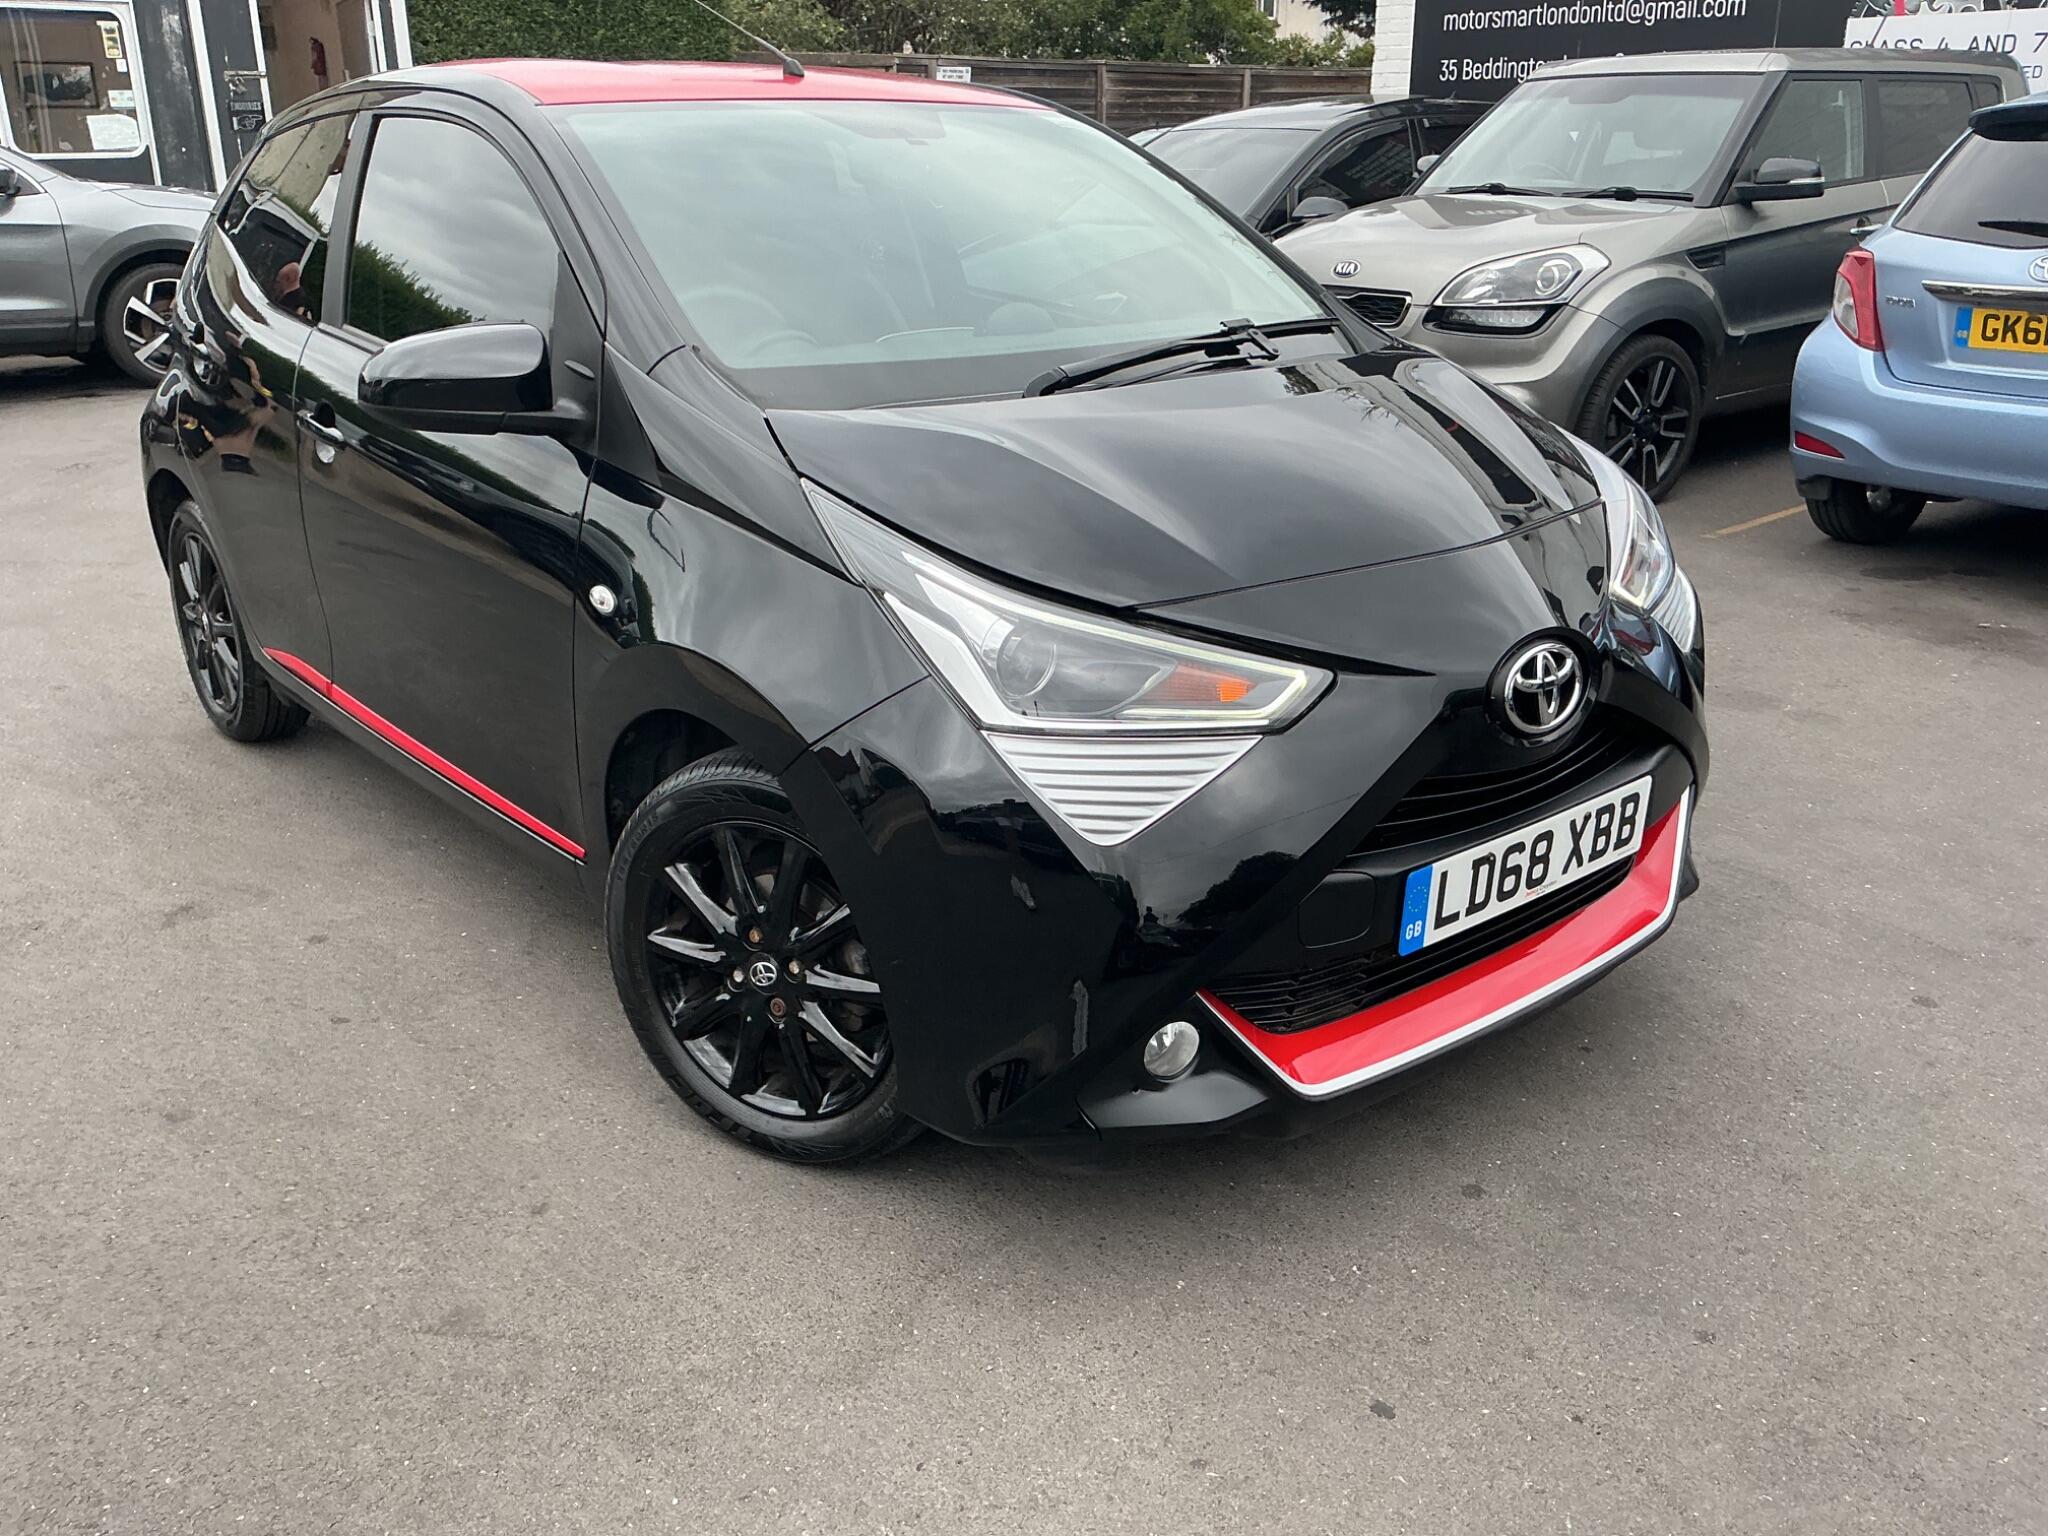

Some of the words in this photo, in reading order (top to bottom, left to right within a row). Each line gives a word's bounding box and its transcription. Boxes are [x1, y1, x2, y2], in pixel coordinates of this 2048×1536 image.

[1443, 0, 1746, 31] motorsmartlondonltd@gmail.com
[1967, 34, 2018, 54] AND
[2033, 32, 2048, 53] 7
[1439, 59, 1458, 81] 35
[1335, 261, 1356, 274] KIA
[1433, 829, 1554, 931] LD68
[1561, 791, 1641, 876] XBB
[1404, 919, 1423, 941] GB
